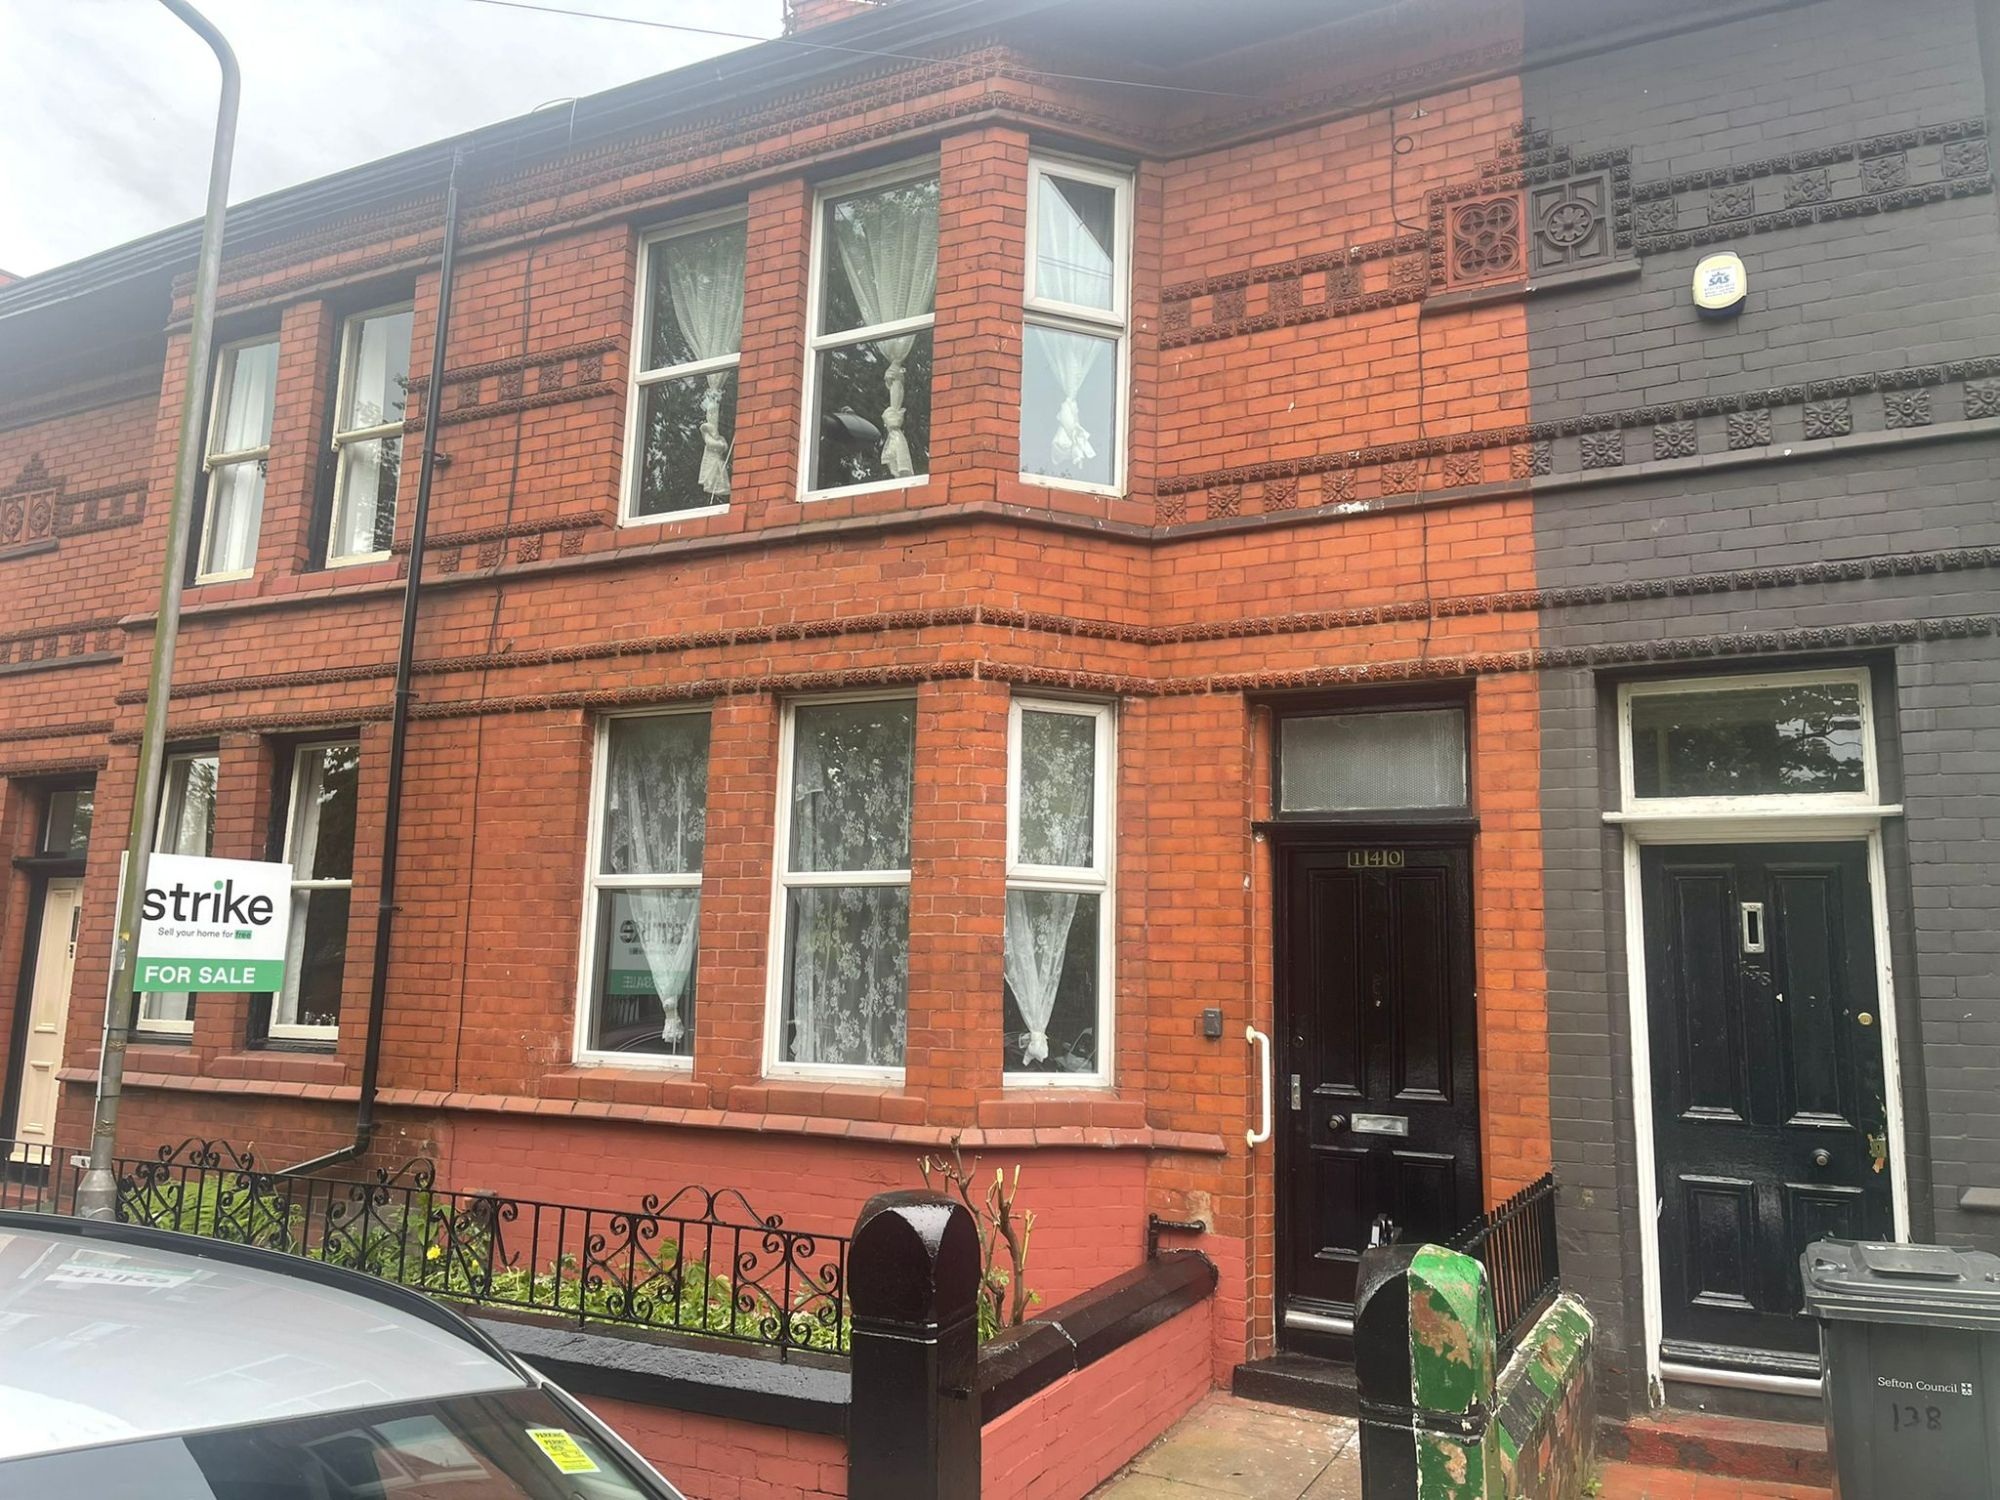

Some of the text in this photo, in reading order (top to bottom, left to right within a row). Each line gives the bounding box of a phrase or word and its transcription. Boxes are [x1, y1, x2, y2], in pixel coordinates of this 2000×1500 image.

[1353, 850, 1401, 866] 140
[142, 878, 274, 926] strike
[158, 927, 252, 939] Sell your home for free
[144, 965, 256, 984] FOR SALE
[1878, 1376, 1958, 1393] Sefton Council
[1892, 1402, 1942, 1432] 138
